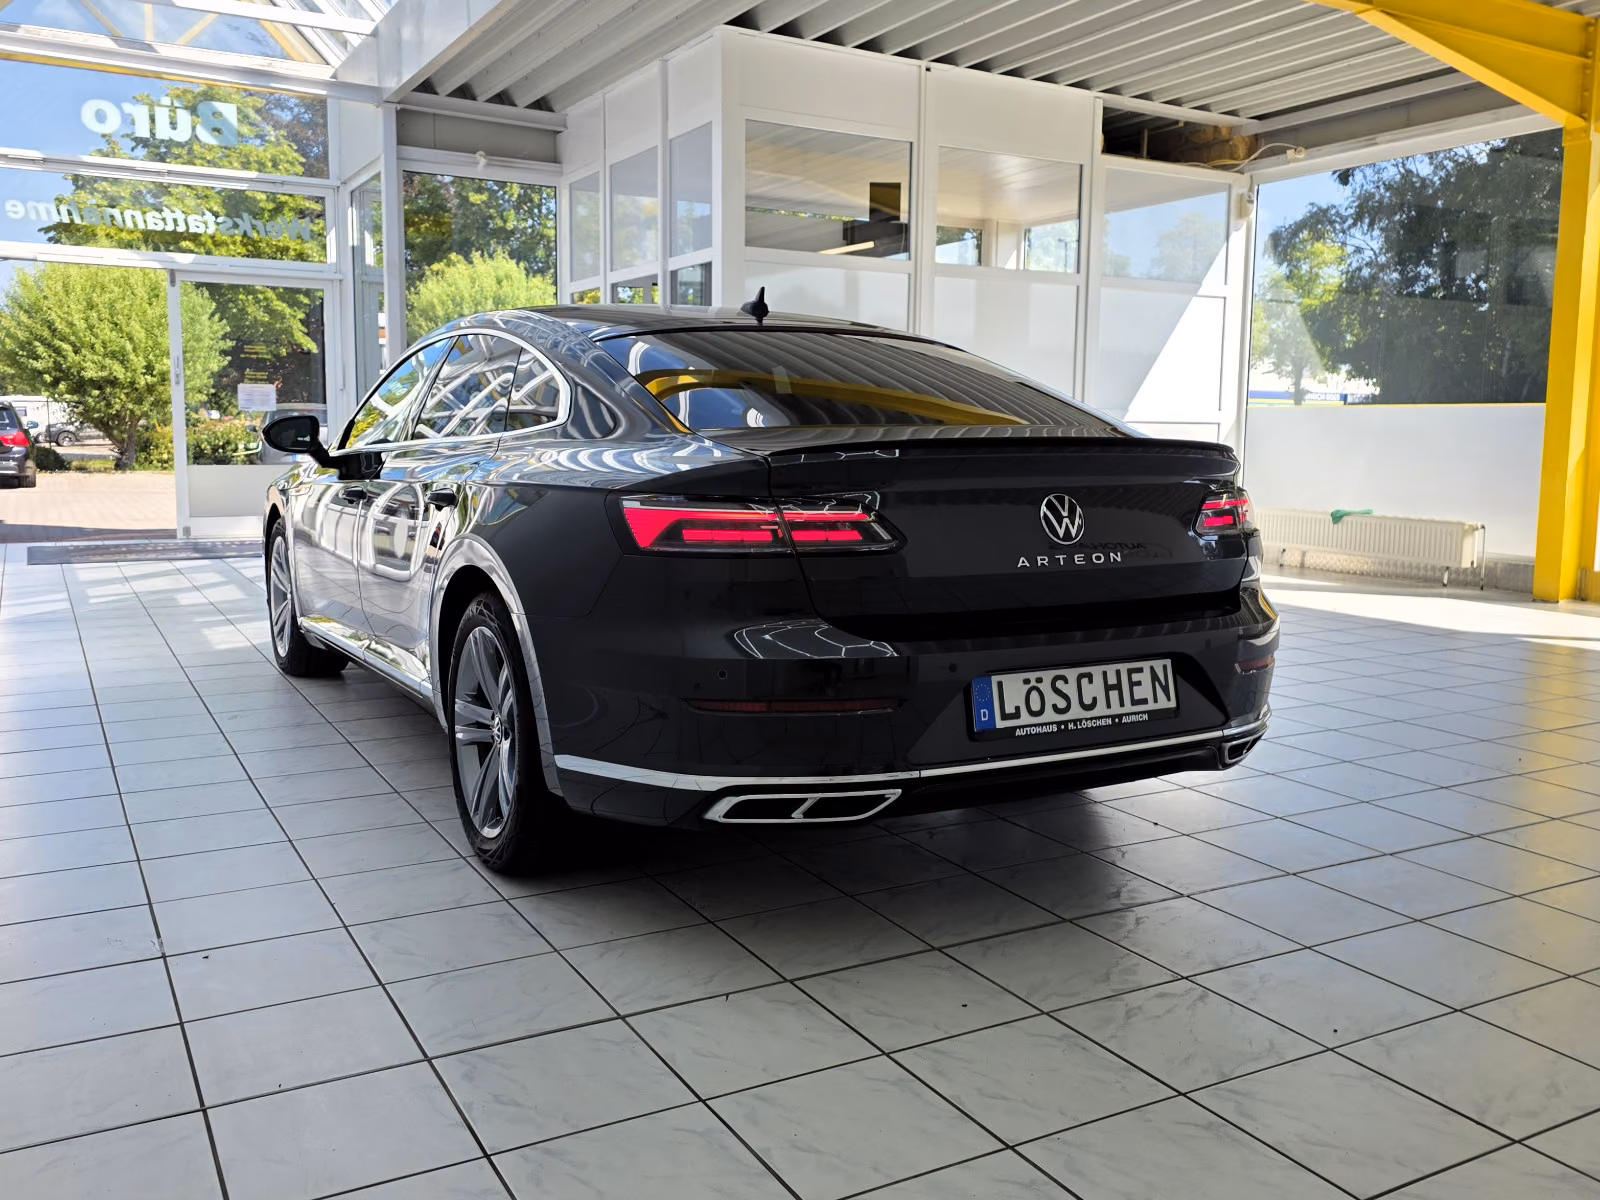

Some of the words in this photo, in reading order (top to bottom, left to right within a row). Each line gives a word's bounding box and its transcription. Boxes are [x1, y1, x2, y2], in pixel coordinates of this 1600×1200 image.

[1017, 551, 1122, 568] ARTEON
[997, 664, 1171, 721] LÖSCHEN
[980, 708, 989, 721] D
[1015, 724, 1058, 736] AUTOHAUS
[1122, 713, 1149, 724] AURICH
